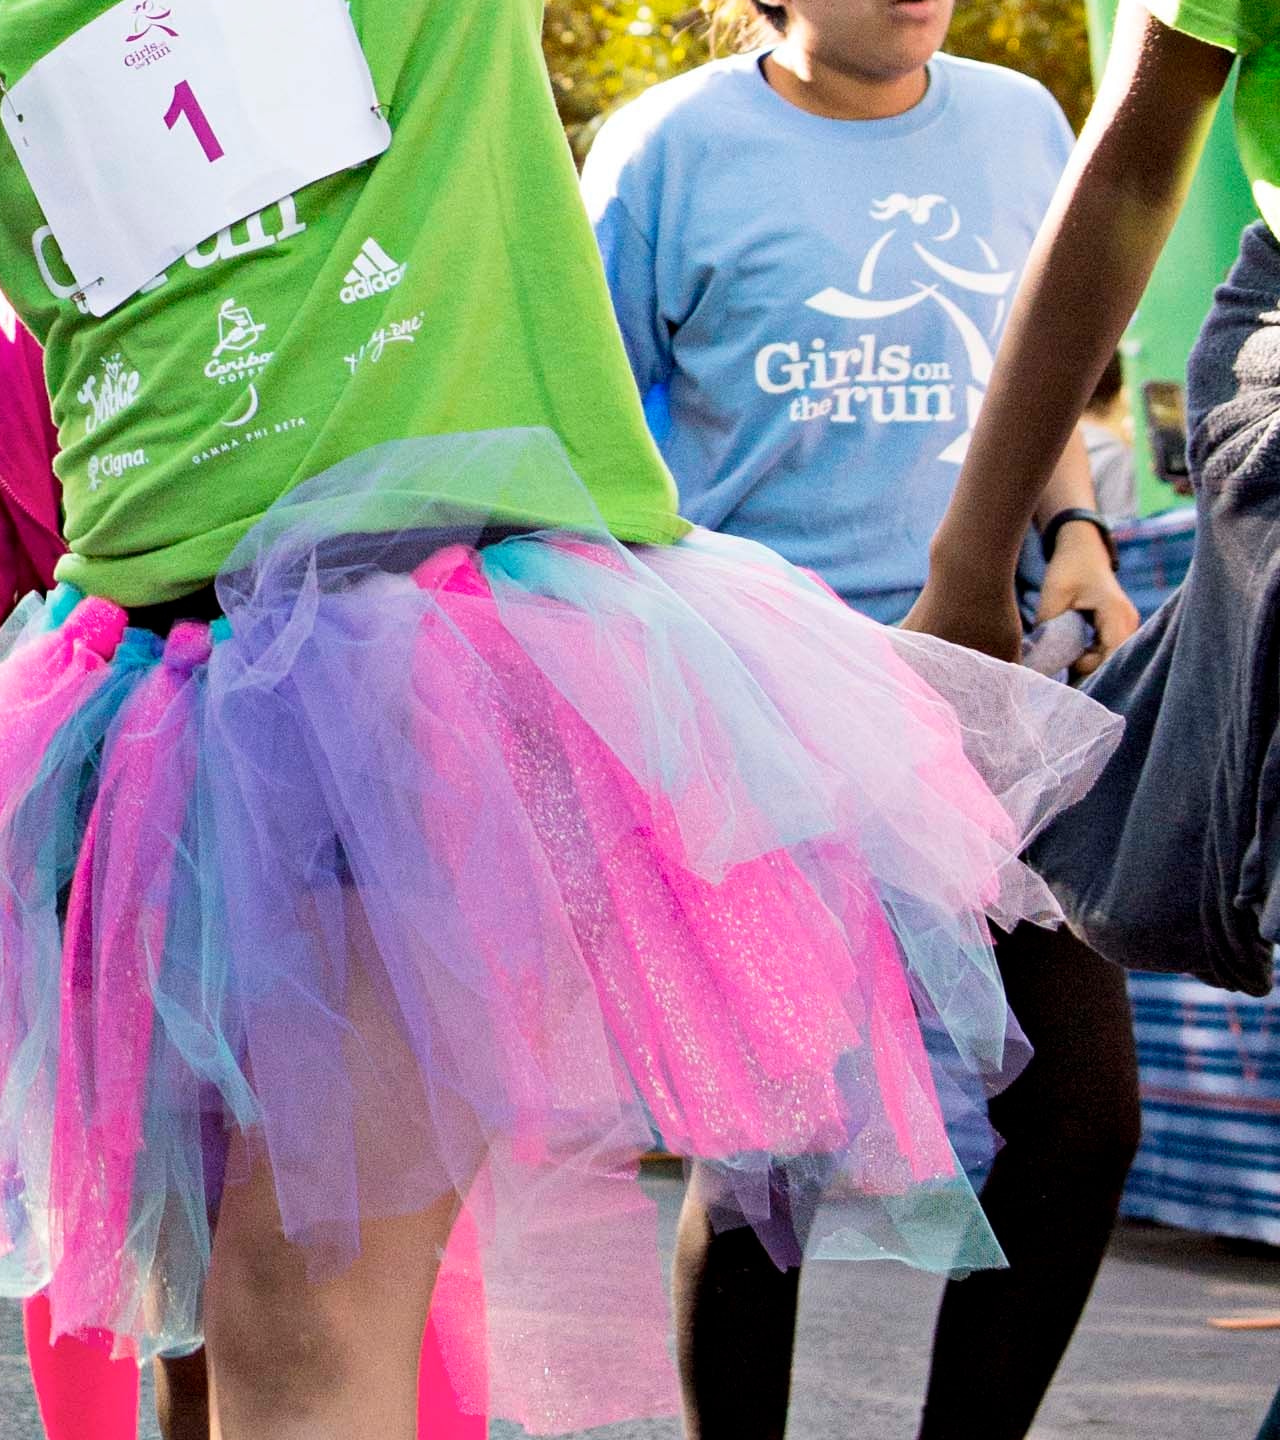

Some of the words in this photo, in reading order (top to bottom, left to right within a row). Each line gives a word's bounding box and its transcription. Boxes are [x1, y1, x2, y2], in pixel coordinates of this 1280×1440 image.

[124, 41, 158, 68] Girls
[163, 78, 225, 164] 1
[203, 350, 276, 378] Caribo
[754, 334, 912, 395] Girls
[912, 359, 953, 383] on
[789, 396, 832, 422] the
[831, 384, 956, 424] run
[246, 427, 269, 443] PHI
[274, 416, 306, 433] BETA
